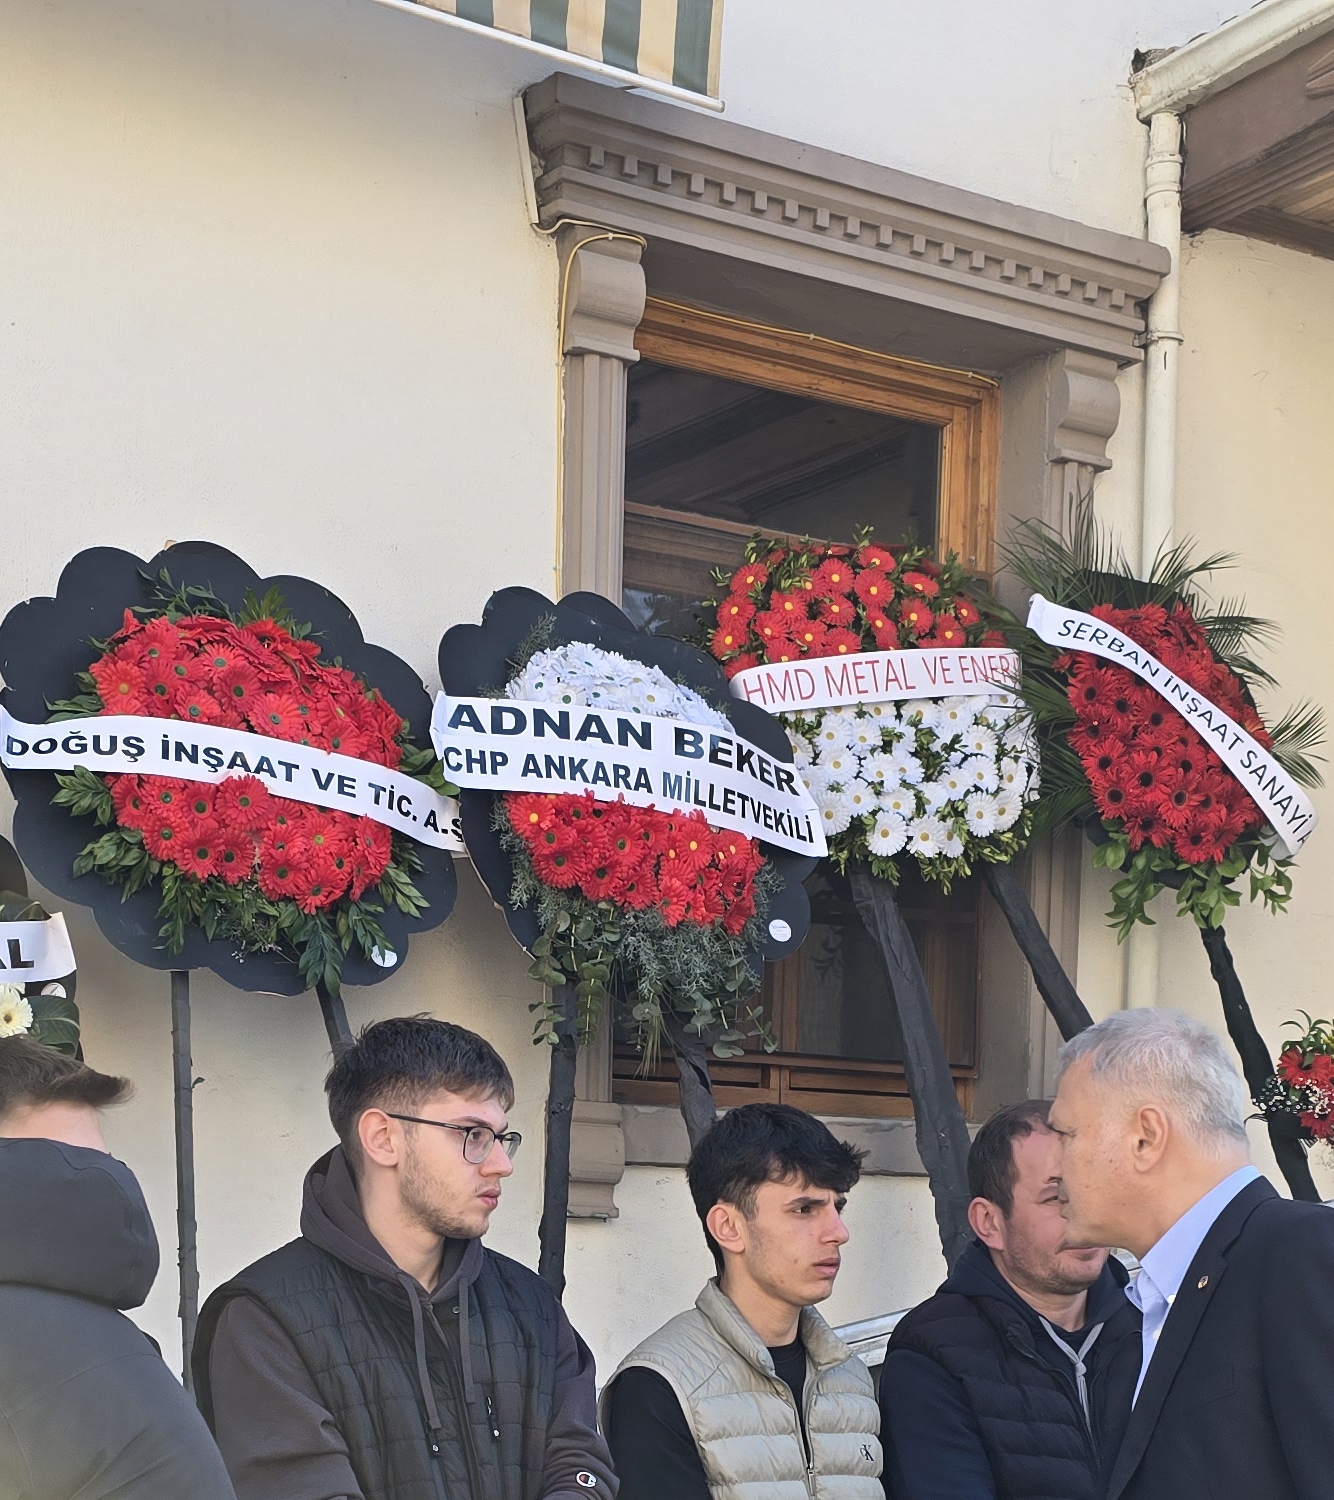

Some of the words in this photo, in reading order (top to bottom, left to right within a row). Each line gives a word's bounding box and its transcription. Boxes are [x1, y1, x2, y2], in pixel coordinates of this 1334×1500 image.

[743, 668, 816, 706] HMD
[824, 657, 916, 698] METAL
[922, 655, 954, 685] VE
[1057, 619, 1160, 678] SERBAN
[1164, 675, 1245, 751] İNŞAAT
[1240, 750, 1313, 834] SANAYİ
[5, 730, 147, 762] DOĞUŞ
[161, 733, 299, 783] İNŞAAT
[311, 768, 357, 799] VE
[367, 781, 418, 822] TİC.
[443, 746, 509, 776] CHP
[520, 753, 654, 794] ANKARA
[662, 770, 815, 844] MİLLETVEKİLİ
[447, 704, 653, 751] ADNAN
[673, 726, 801, 797] BEKER
